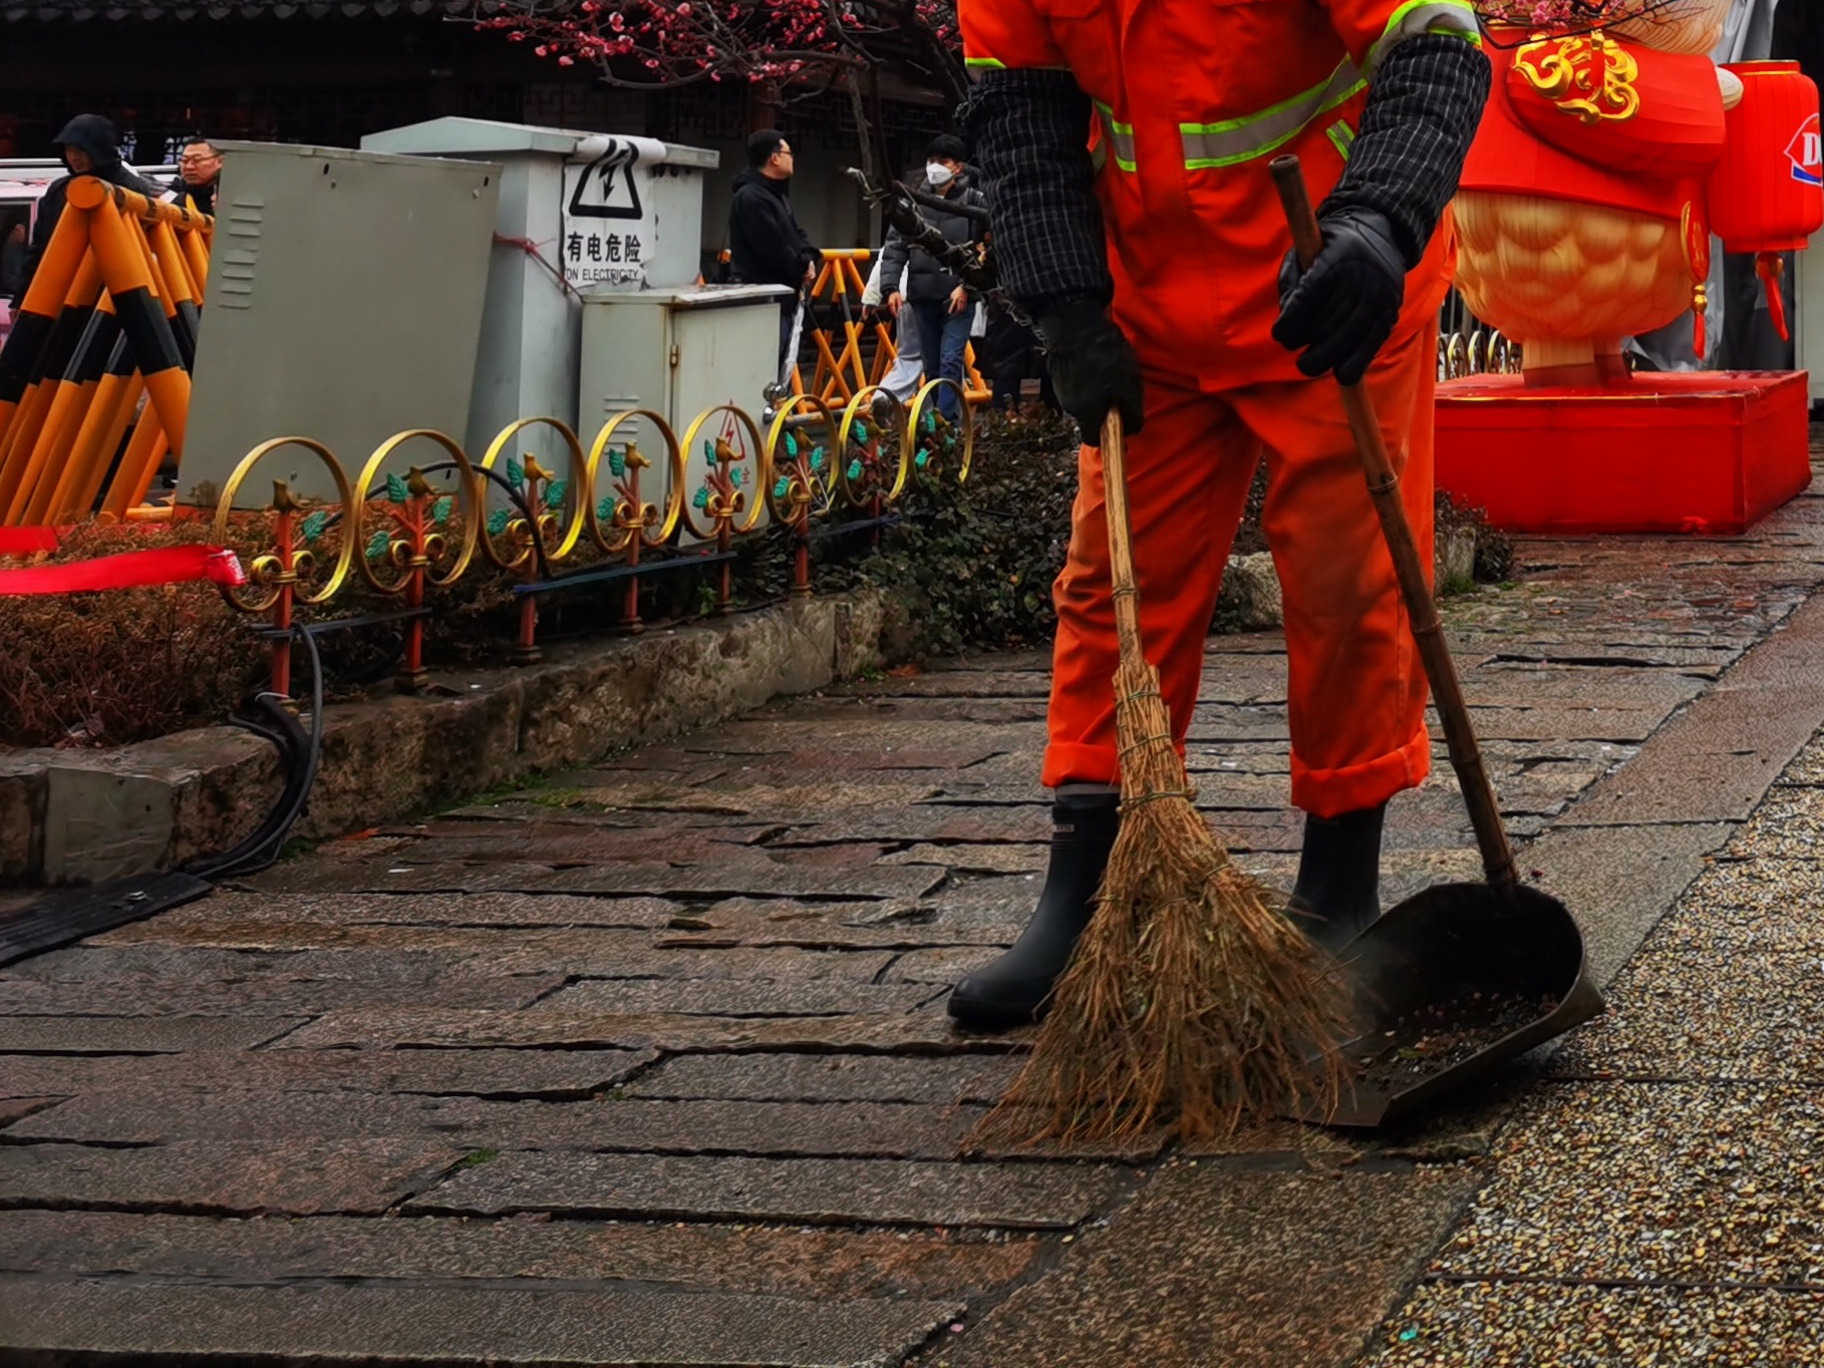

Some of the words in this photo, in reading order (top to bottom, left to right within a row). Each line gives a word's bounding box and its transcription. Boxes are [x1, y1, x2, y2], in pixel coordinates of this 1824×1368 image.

[1802, 132, 1822, 166] D
[567, 231, 641, 263] 有电危险
[582, 268, 639, 282] ELECTRICTY
